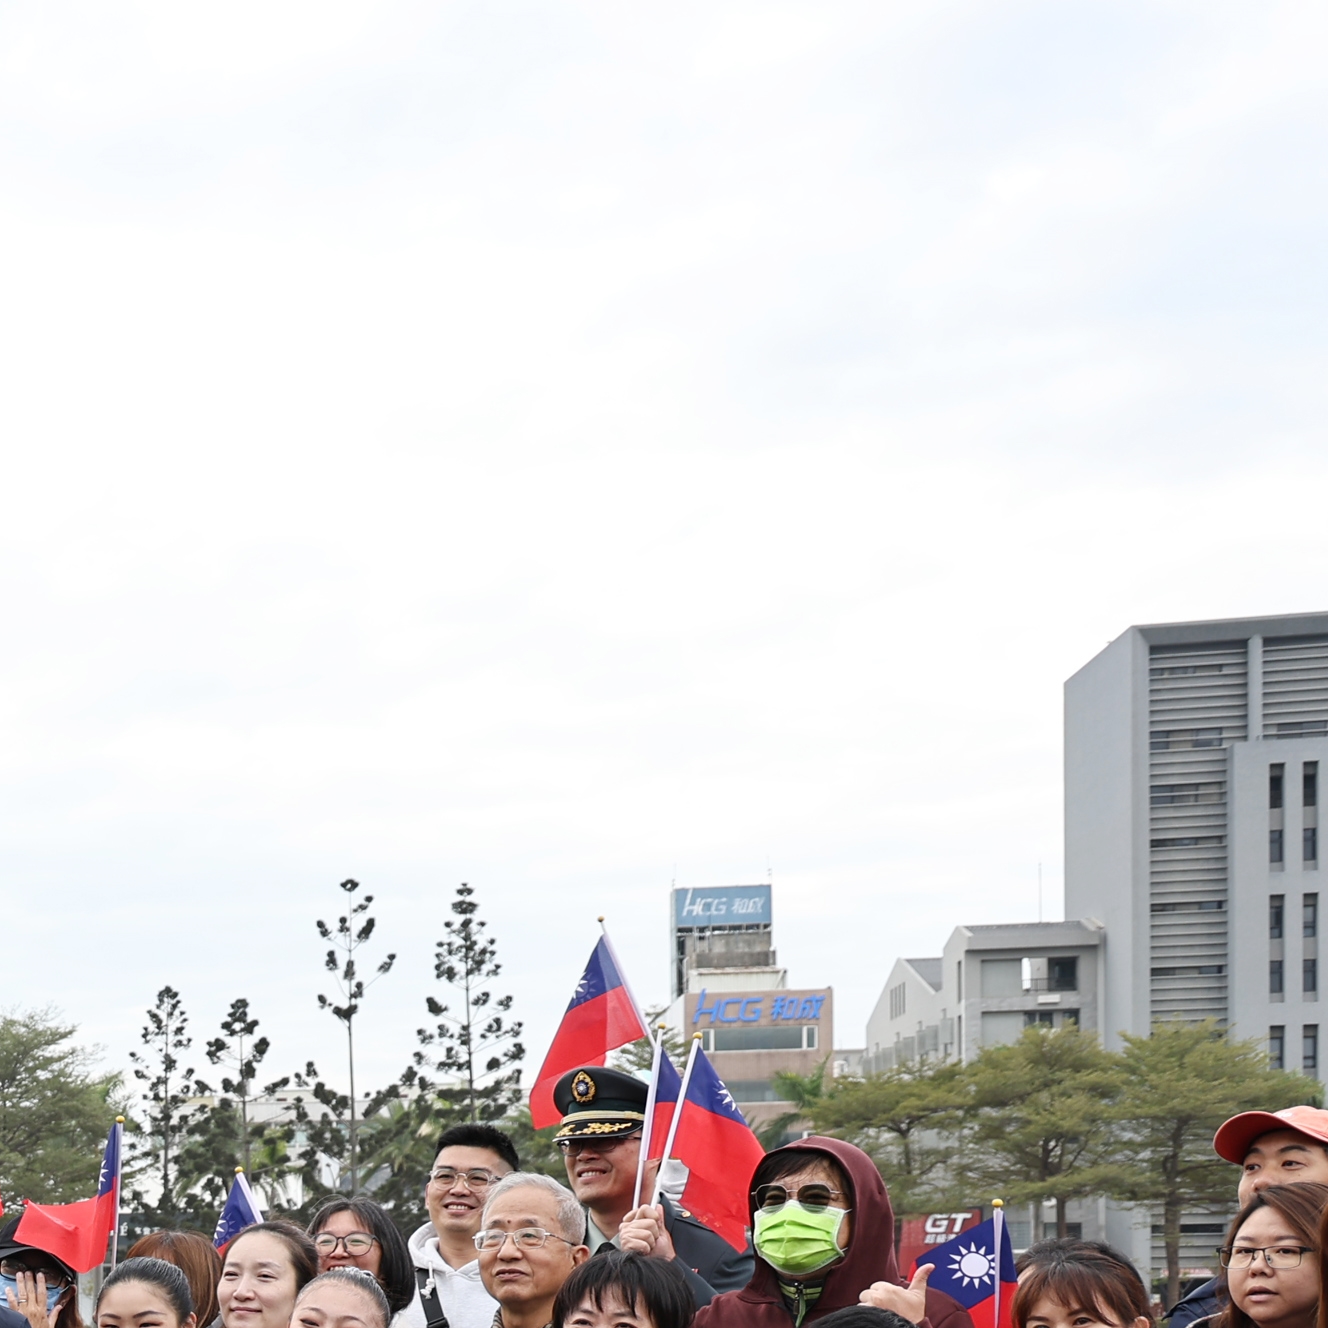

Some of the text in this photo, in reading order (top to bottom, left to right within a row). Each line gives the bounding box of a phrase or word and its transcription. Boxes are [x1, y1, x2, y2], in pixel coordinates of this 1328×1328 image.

[682, 888, 727, 917] HCG
[693, 988, 827, 1024] HCG 和成
[925, 1213, 972, 1233] GT
